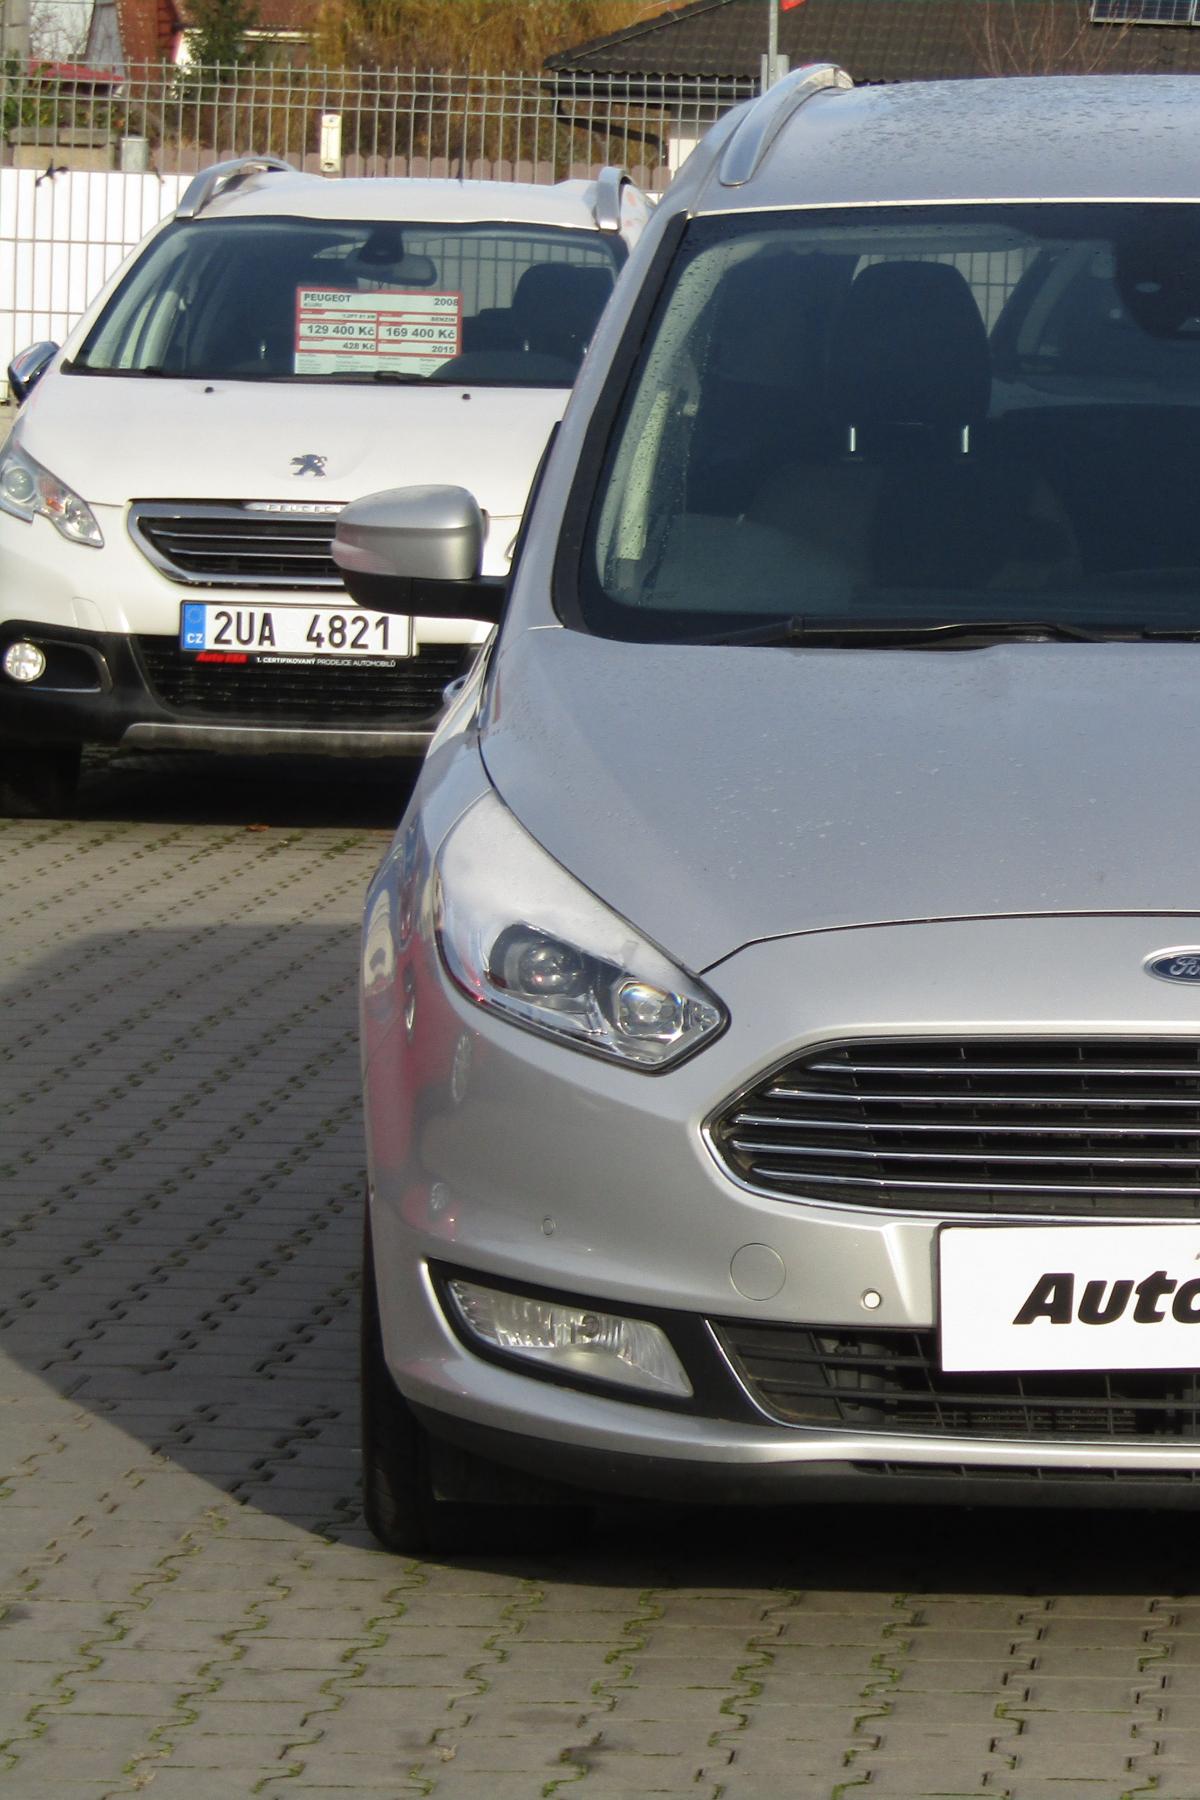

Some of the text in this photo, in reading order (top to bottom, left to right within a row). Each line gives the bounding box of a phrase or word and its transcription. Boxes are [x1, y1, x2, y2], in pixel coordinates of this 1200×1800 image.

[303, 293, 351, 303] PEUGEOT
[433, 297, 459, 307] 2008
[307, 325, 375, 337] 129 400 Kč
[386, 327, 456, 340] 169 400 Kč
[342, 342, 375, 351] 428 Kč
[431, 345, 455, 354] 2015
[214, 611, 390, 650] 2UA 4821
[187, 633, 203, 644] CZ
